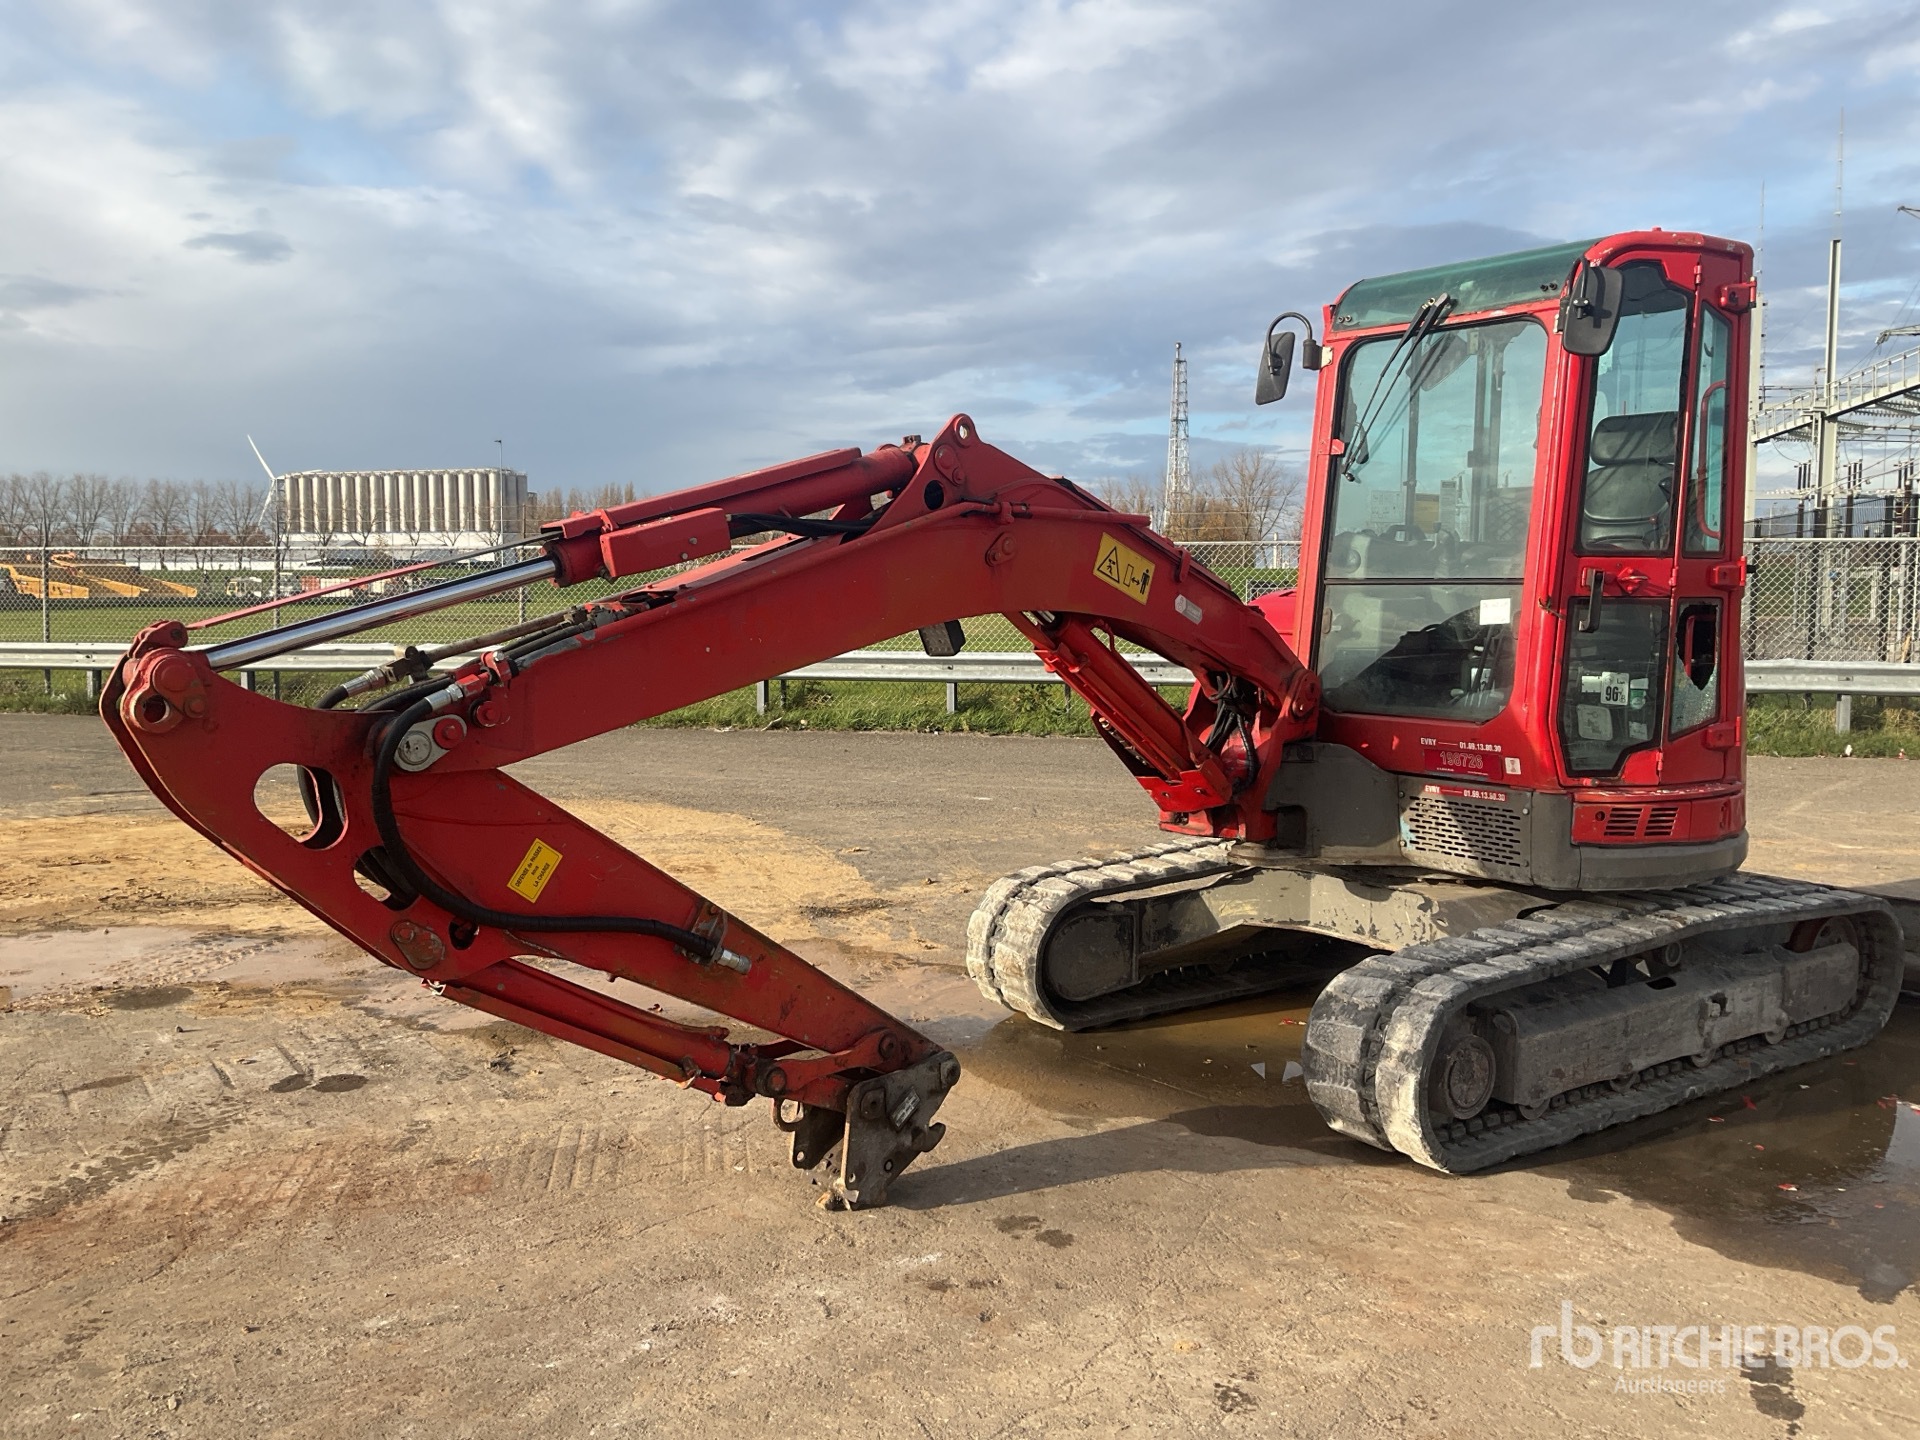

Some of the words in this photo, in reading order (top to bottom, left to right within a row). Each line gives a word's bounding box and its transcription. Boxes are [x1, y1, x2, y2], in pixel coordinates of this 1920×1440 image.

[1605, 685, 1619, 702] 96
[1420, 737, 1437, 746] EVRY
[1439, 750, 1484, 770] 198726
[1424, 784, 1441, 794] EVRY
[533, 880, 540, 888] LA
